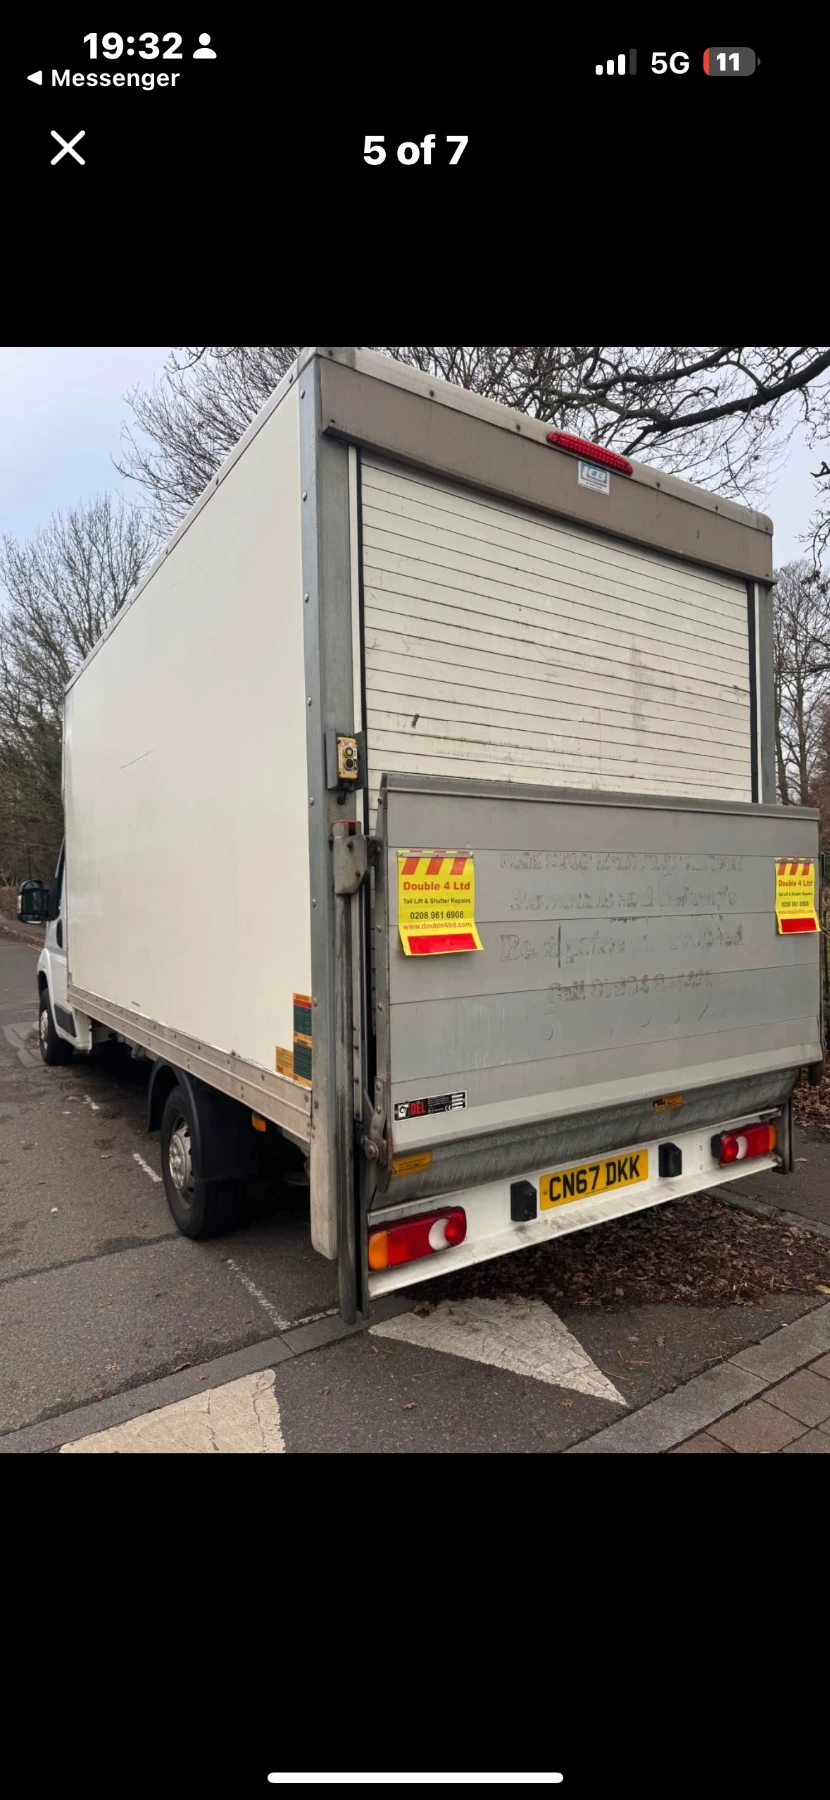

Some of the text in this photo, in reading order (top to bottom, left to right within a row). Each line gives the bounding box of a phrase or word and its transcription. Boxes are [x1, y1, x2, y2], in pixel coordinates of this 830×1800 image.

[403, 881, 471, 891] Double 4 Ltd
[410, 911, 464, 920] 0208 961 6908
[409, 1100, 427, 1116] DEL
[549, 1154, 640, 1202] CN67 DKK
